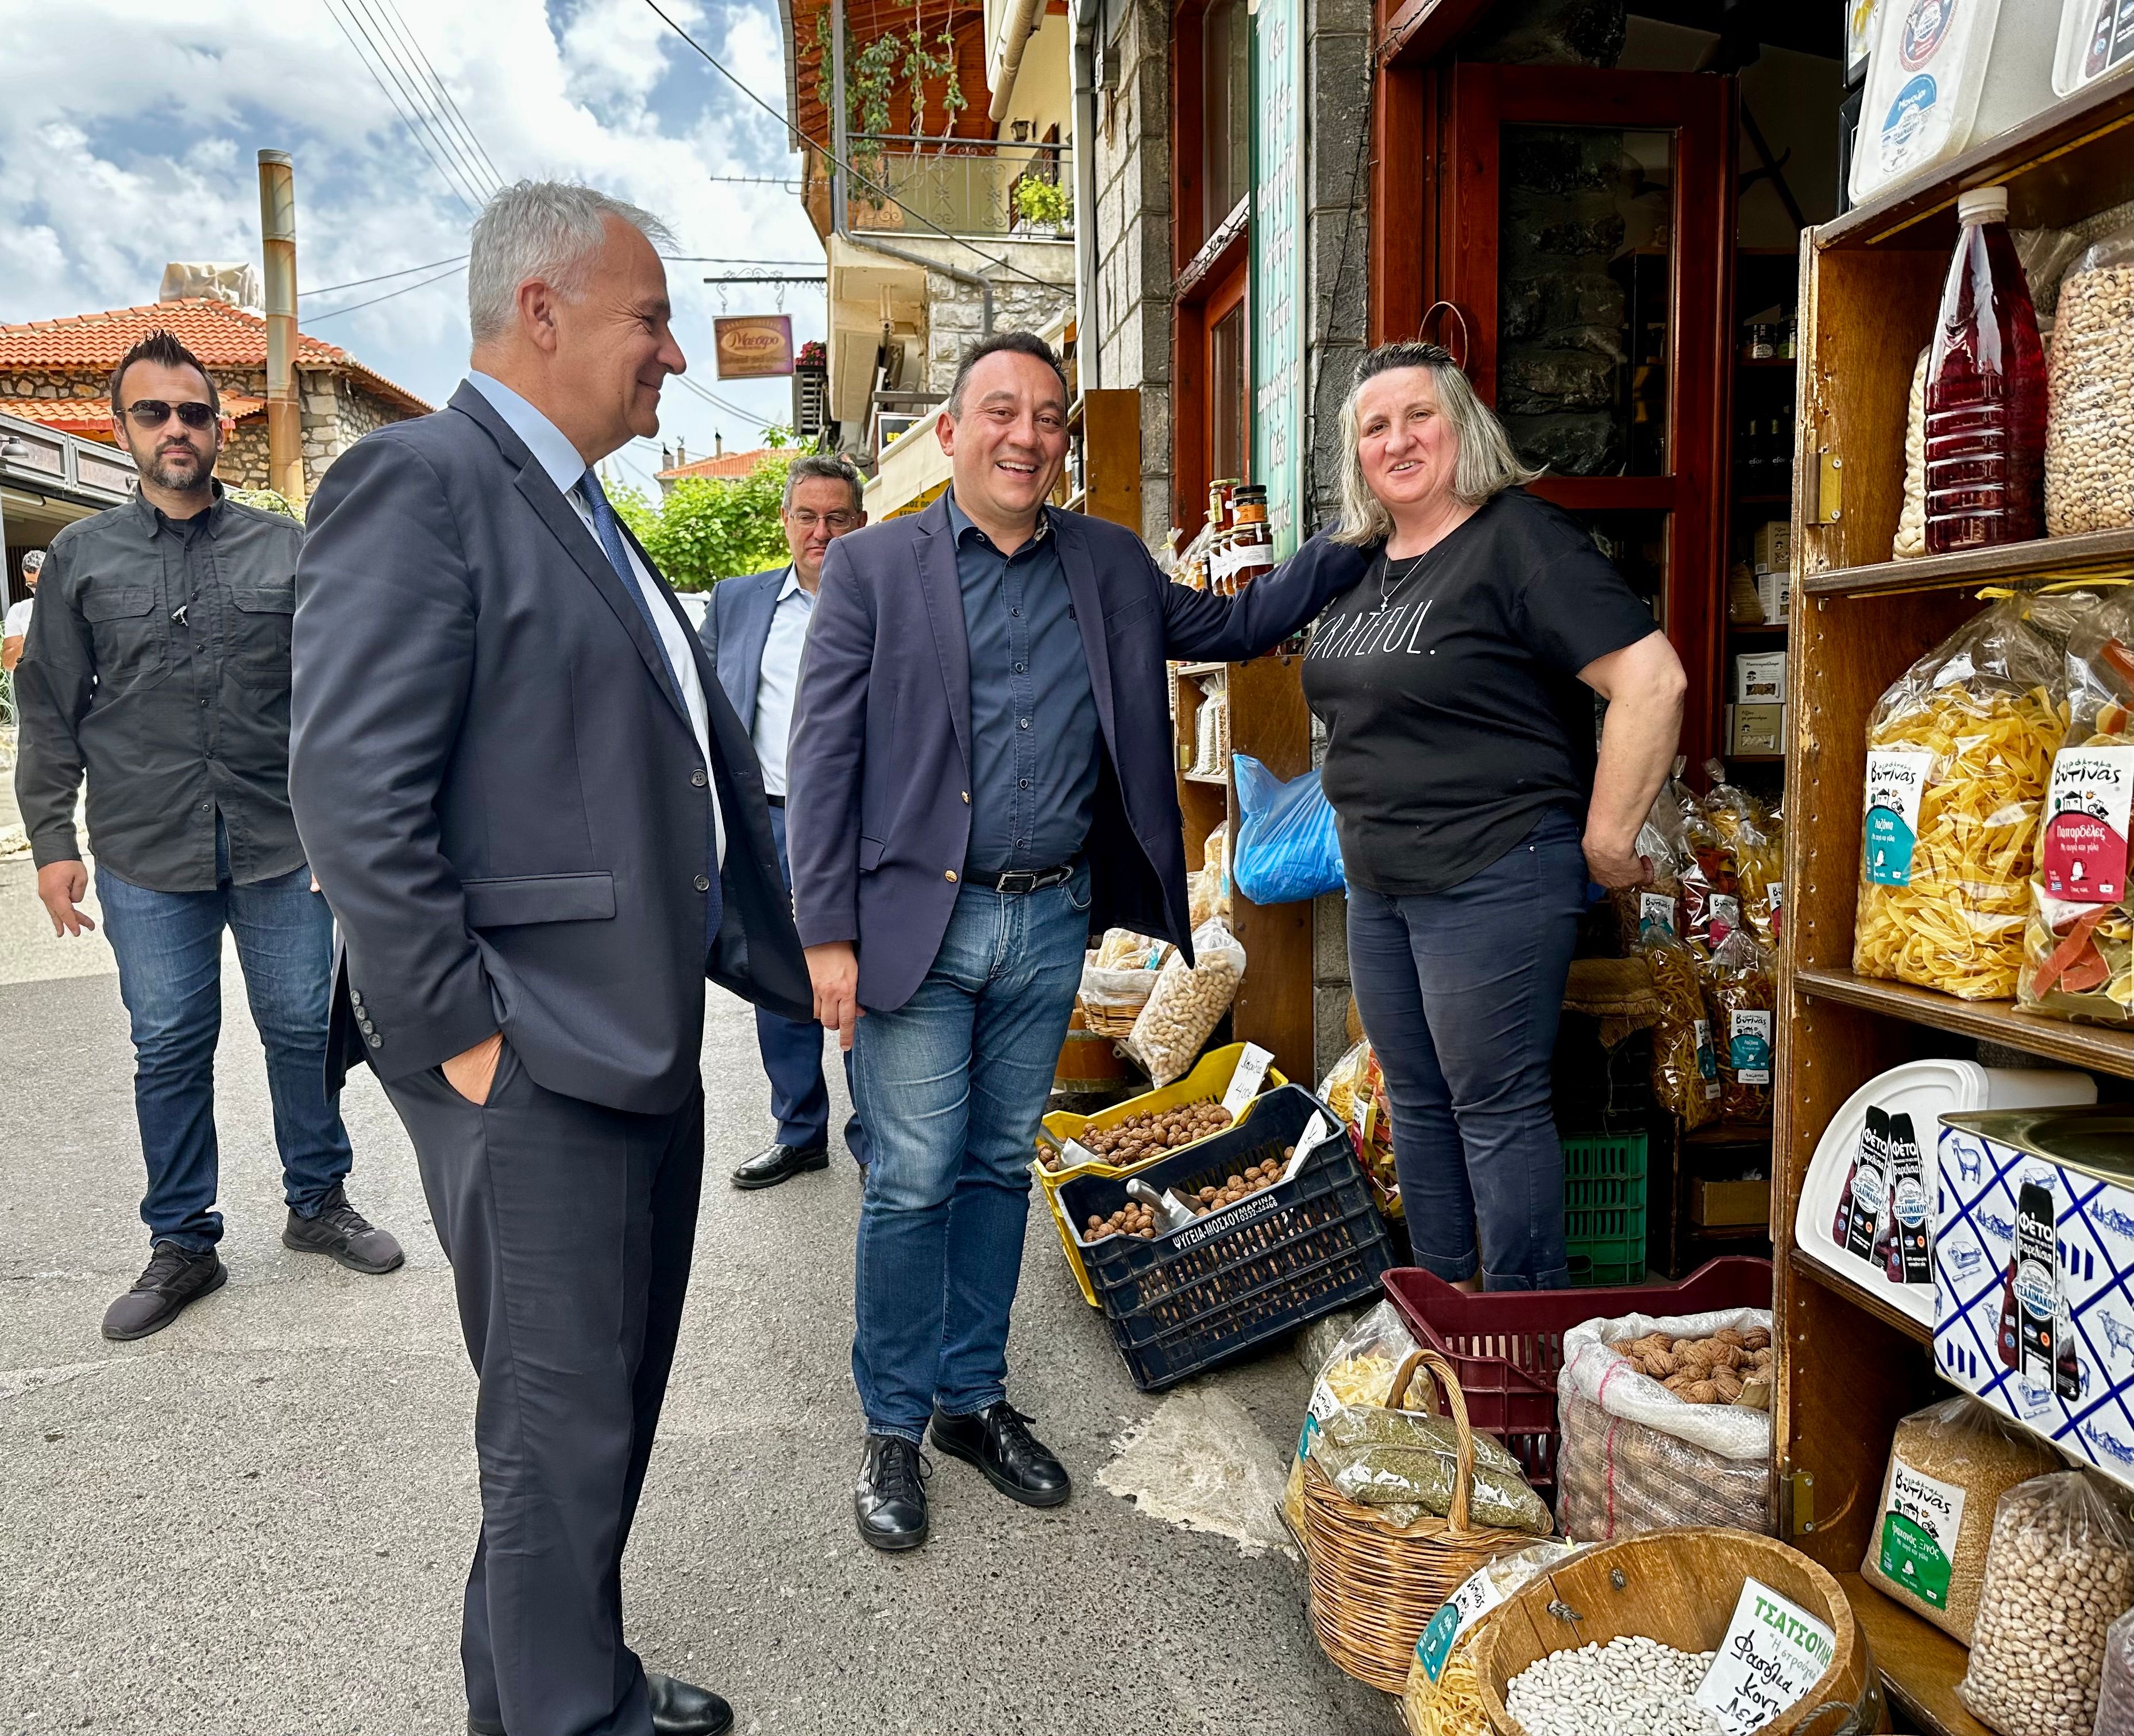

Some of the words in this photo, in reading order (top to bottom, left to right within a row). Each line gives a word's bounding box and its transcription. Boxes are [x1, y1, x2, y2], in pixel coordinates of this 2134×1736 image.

[1871, 761, 1917, 785] Βυτίνας
[2055, 761, 2122, 785] Βυτίνας
[2057, 824, 2105, 842] Παπαρδέλες
[1863, 1128, 1887, 1154] Φέτα
[1892, 1137, 1917, 1157] Φέτα
[1853, 1182, 1882, 1206] ΤΣΑΛΙΜΑΚΟΥ
[1895, 1203, 1927, 1214] ΤΣΑΛΙΜΑΚΟΥ
[2019, 1212, 2053, 1242] Φέτα
[2016, 1283, 2058, 1312] ΤΣΑΛΙΜΑΚΟΥ
[1895, 1468, 1952, 1514] Βυτίνας
[1892, 1521, 1917, 1549] Τραχανάς
[1919, 1538, 1939, 1560] Ξινός
[1754, 1595, 1834, 1669] ΤΣΑΤΣΟΥΛΗ
